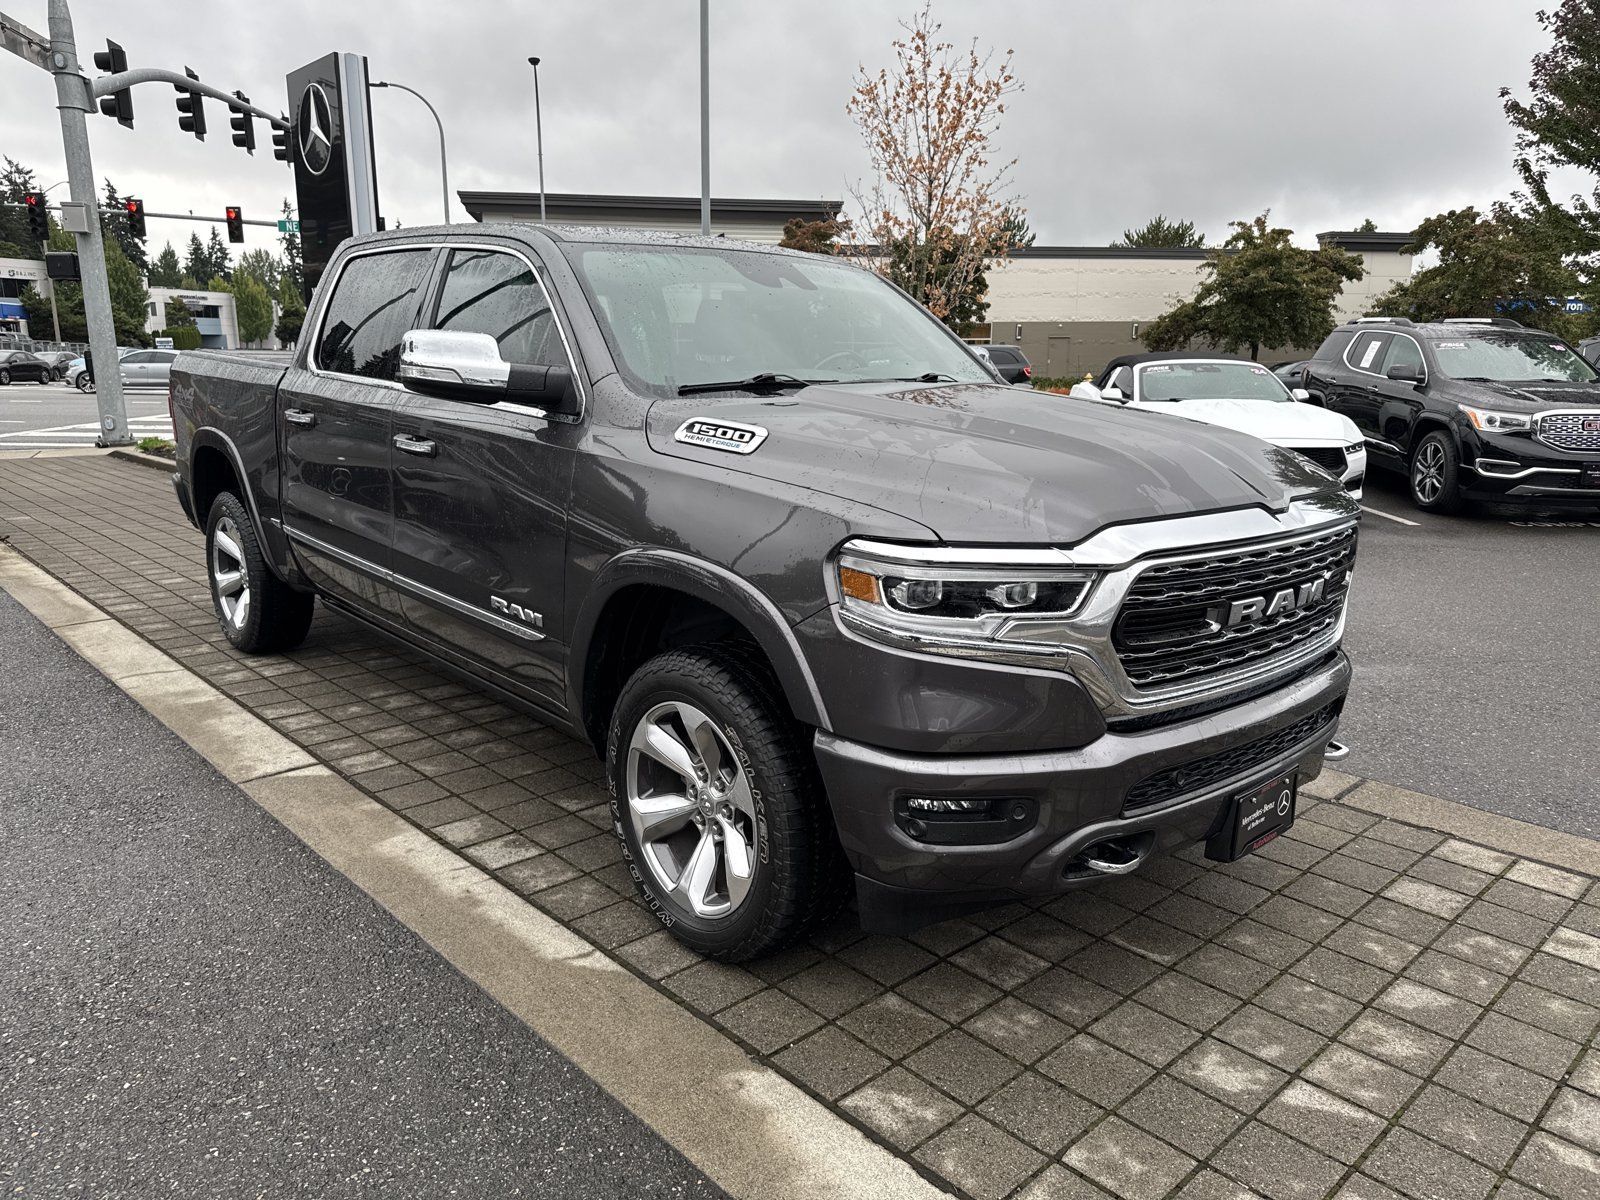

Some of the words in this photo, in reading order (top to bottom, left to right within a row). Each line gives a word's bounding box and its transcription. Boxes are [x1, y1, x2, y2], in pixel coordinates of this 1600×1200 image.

[285, 220, 299, 232] NE
[684, 433, 705, 442] HEMI
[692, 423, 752, 443] 1500
[490, 595, 543, 628] RAM
[1227, 578, 1325, 626] RAM
[1241, 801, 1276, 826] Mercedes-Benz
[608, 775, 676, 928] WILDPEAK
